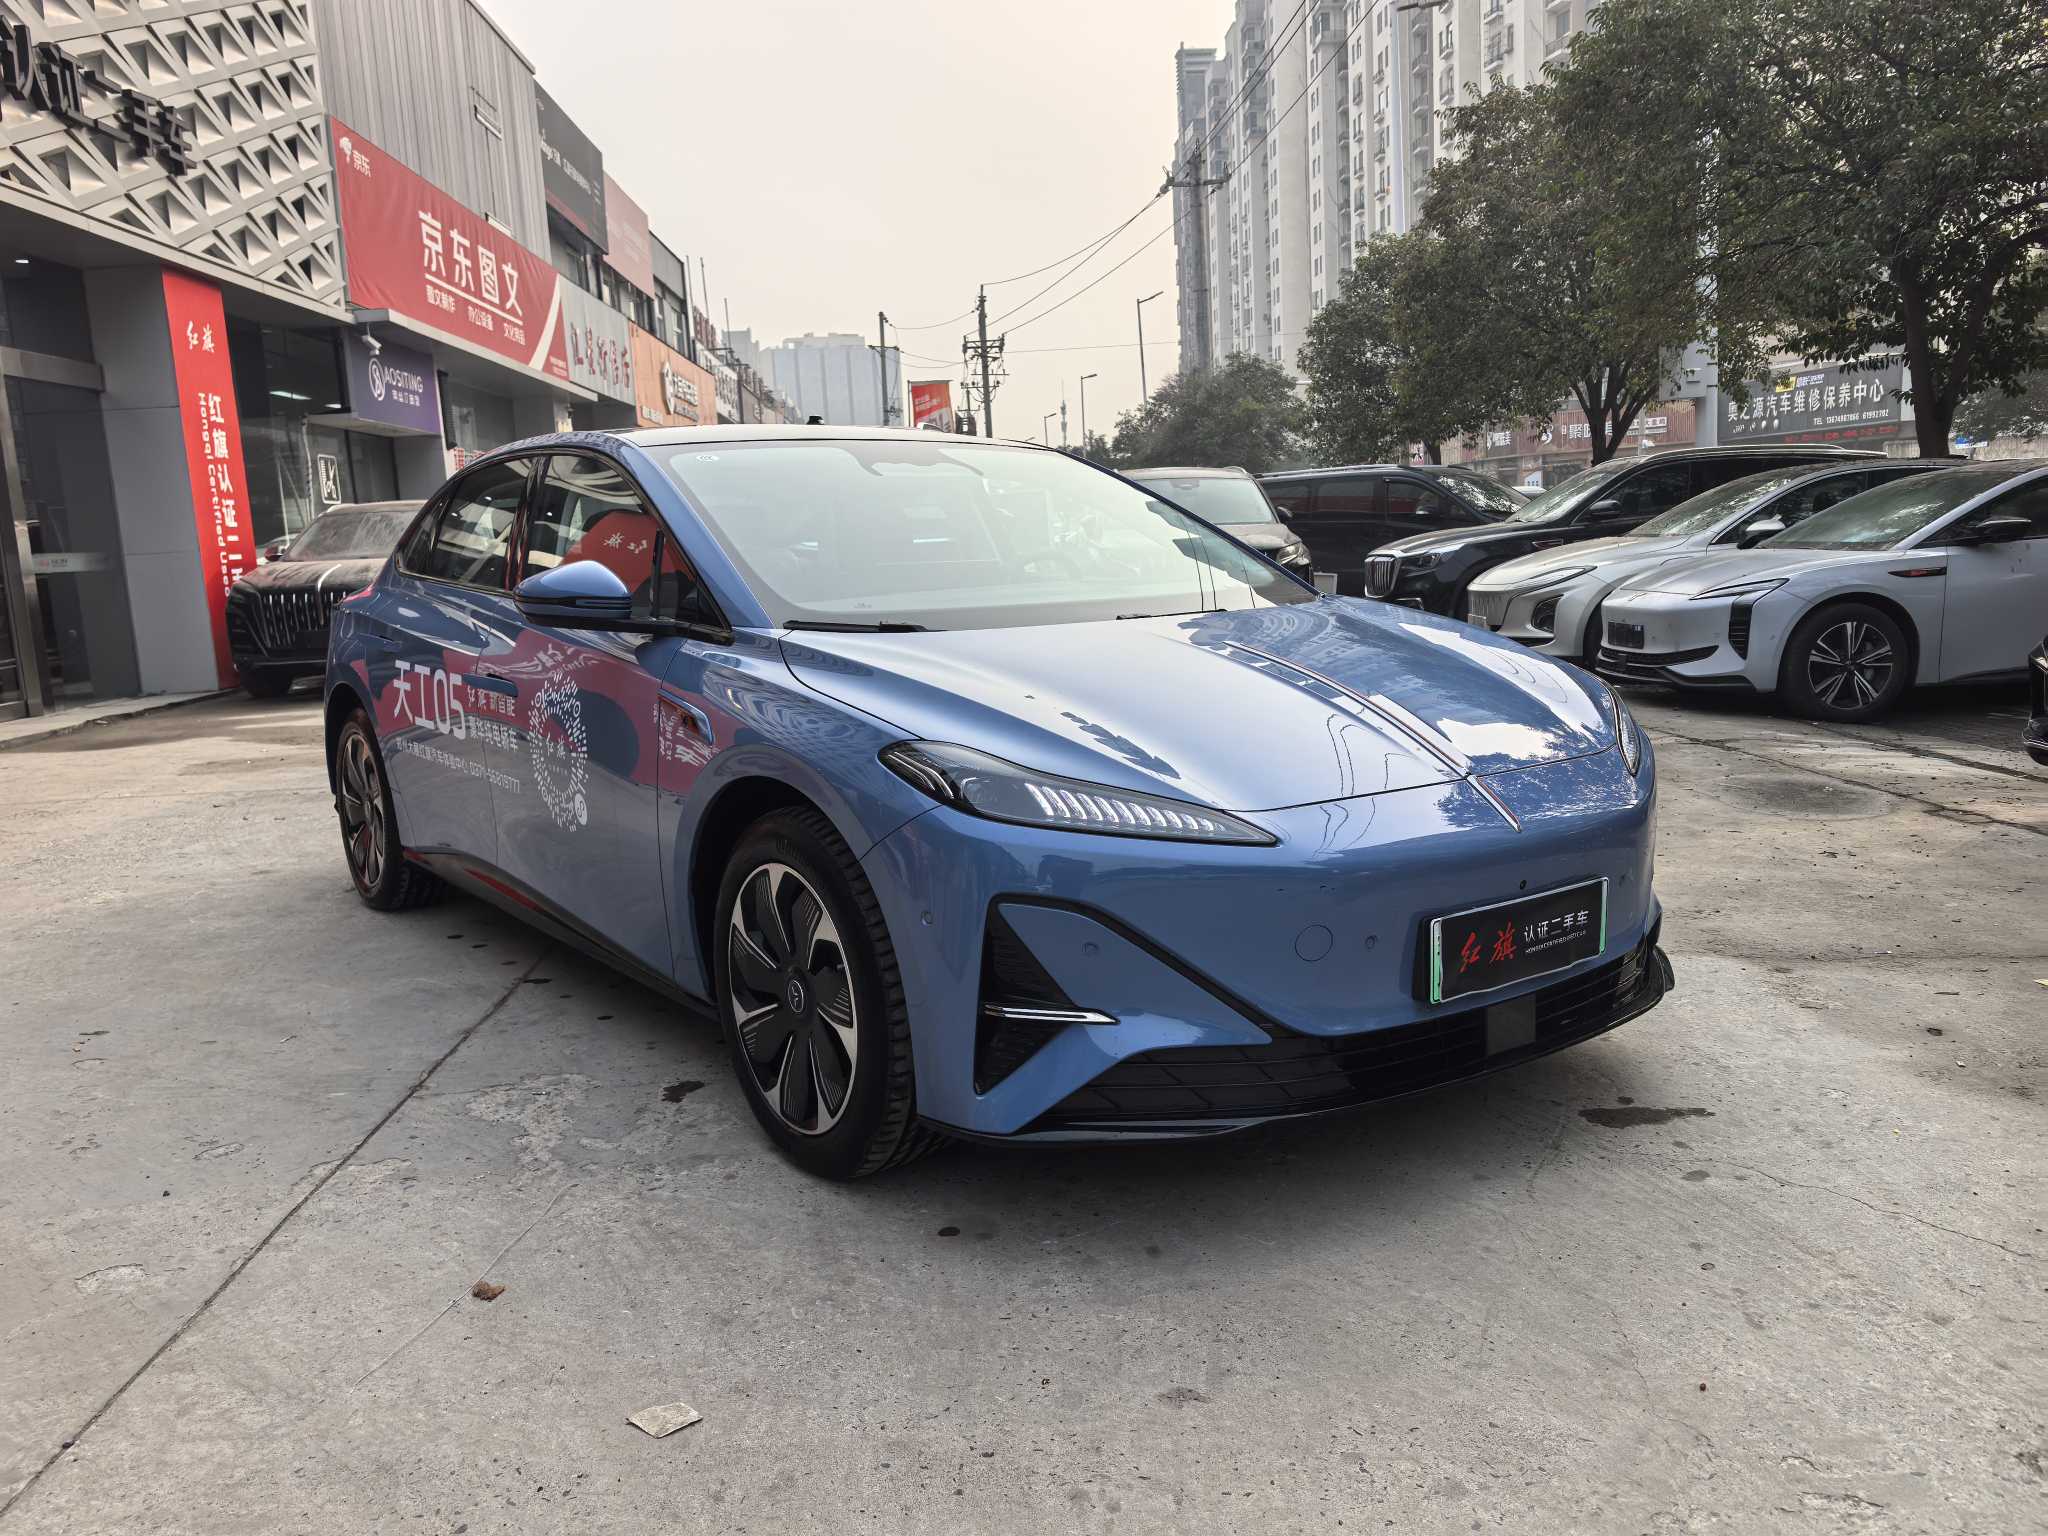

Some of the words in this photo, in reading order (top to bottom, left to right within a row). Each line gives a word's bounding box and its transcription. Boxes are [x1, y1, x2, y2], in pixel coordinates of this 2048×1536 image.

[418, 210, 523, 316] 京东图文
[186, 320, 216, 353] 红旗
[1458, 922, 1517, 973] 红旗
[1524, 909, 1589, 943] 认证二手车
